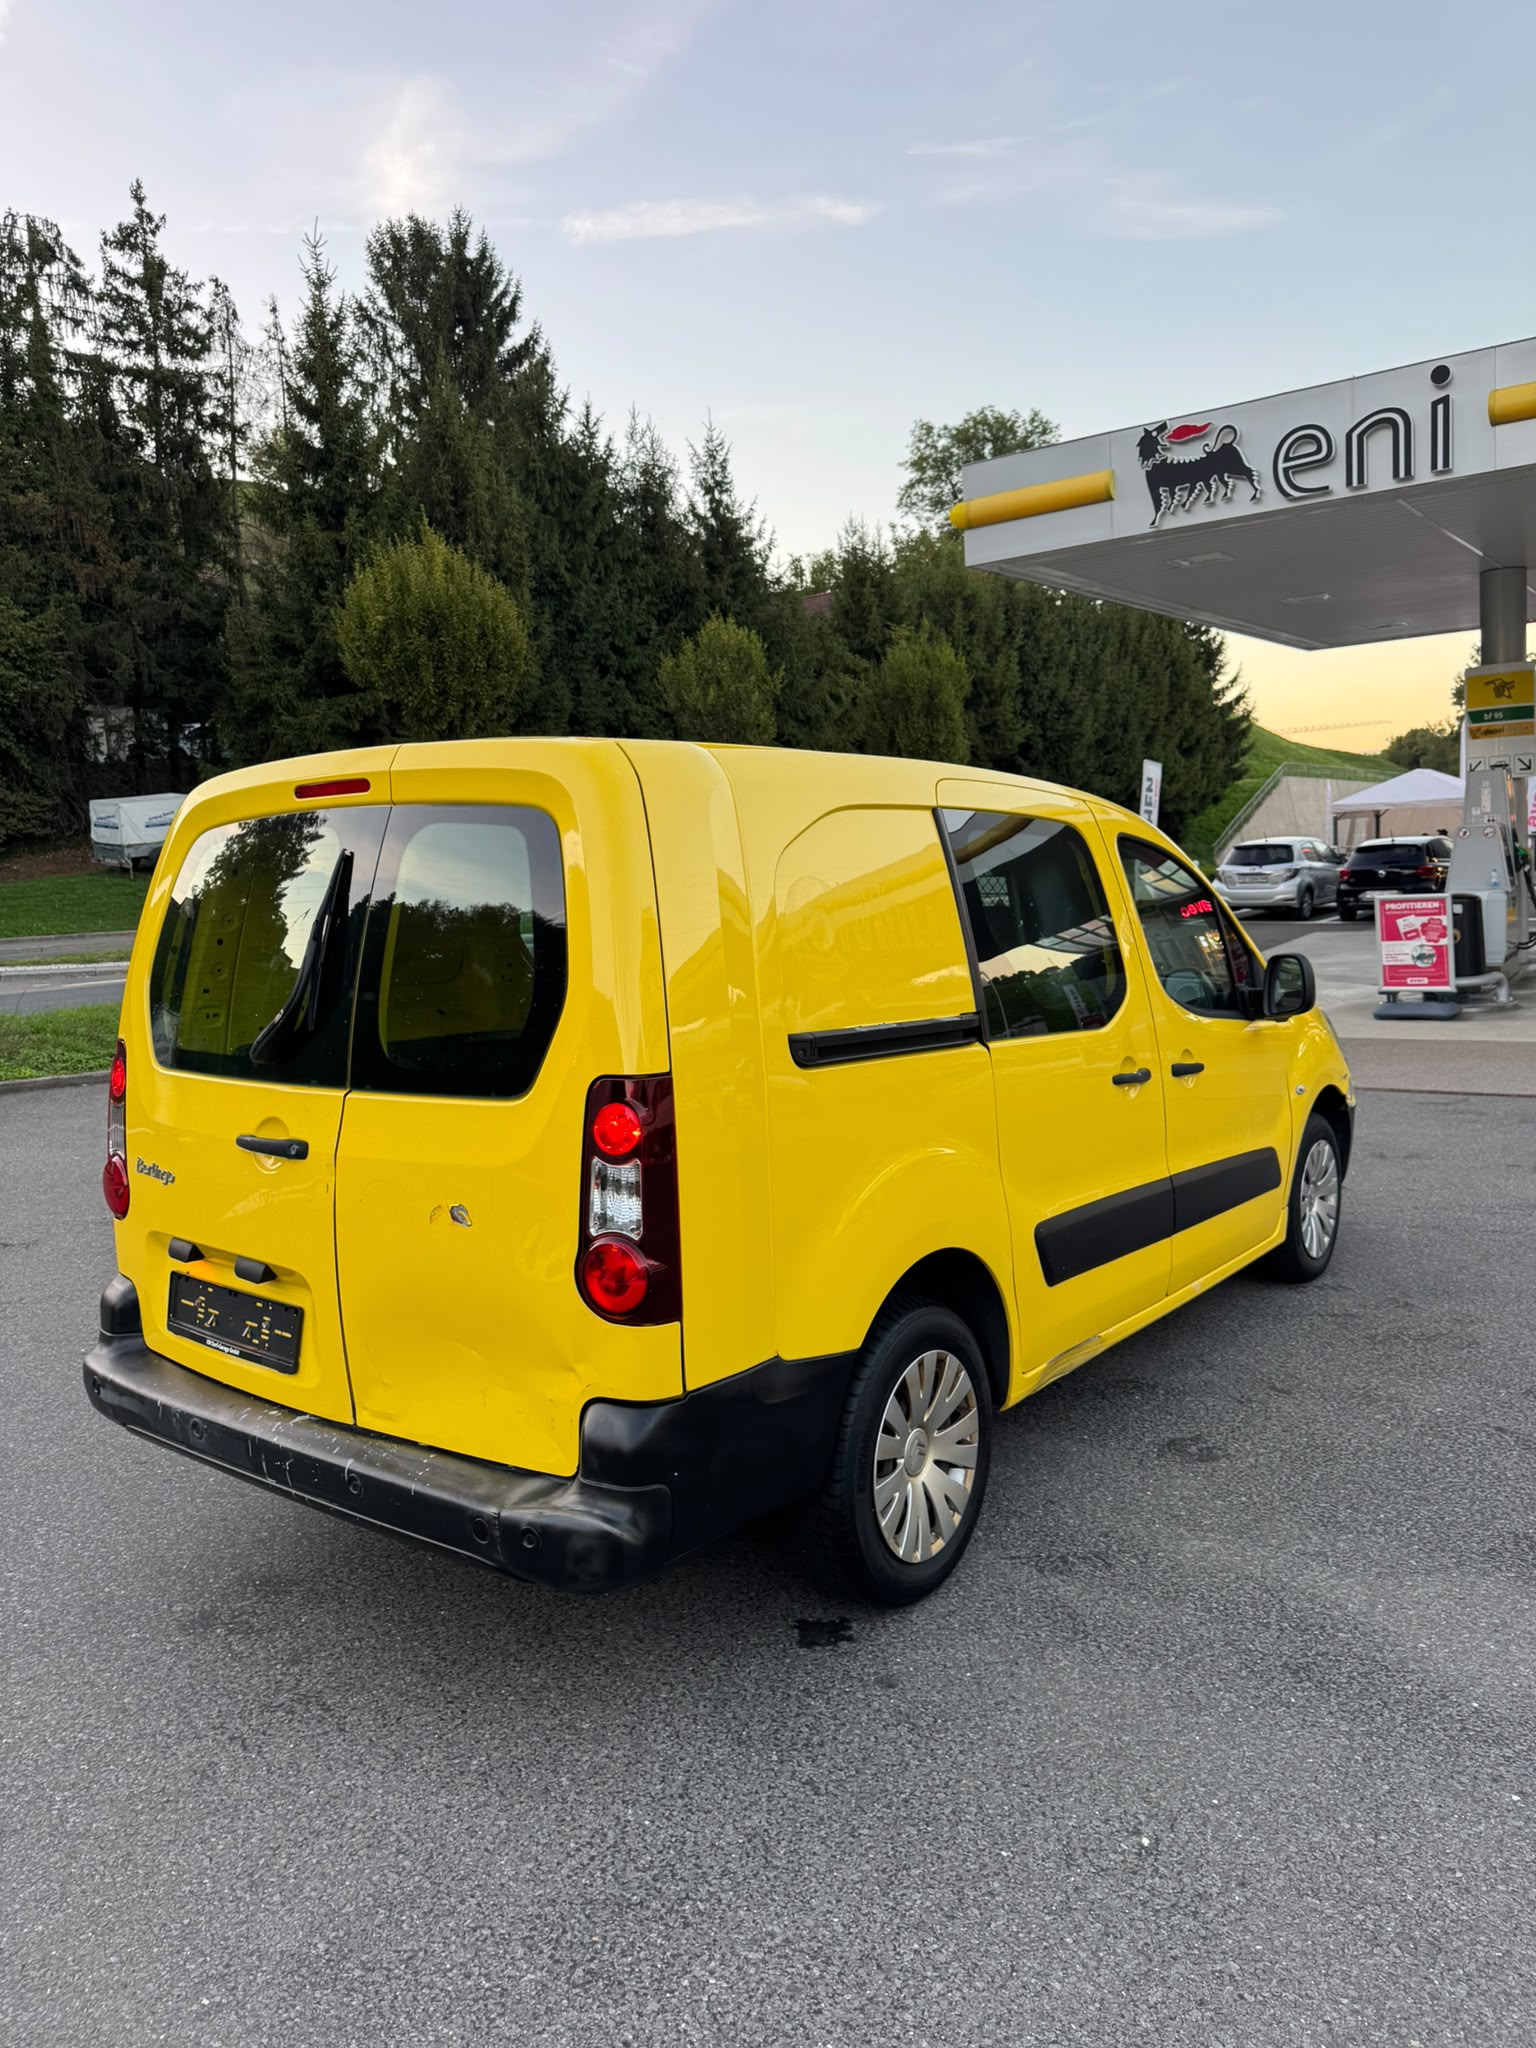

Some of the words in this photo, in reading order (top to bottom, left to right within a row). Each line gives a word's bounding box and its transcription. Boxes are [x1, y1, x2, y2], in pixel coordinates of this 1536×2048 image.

[1273, 364, 1452, 499] eni
[1385, 901, 1439, 910] PROFITIEREN
[137, 1157, 175, 1185] Berlingo
